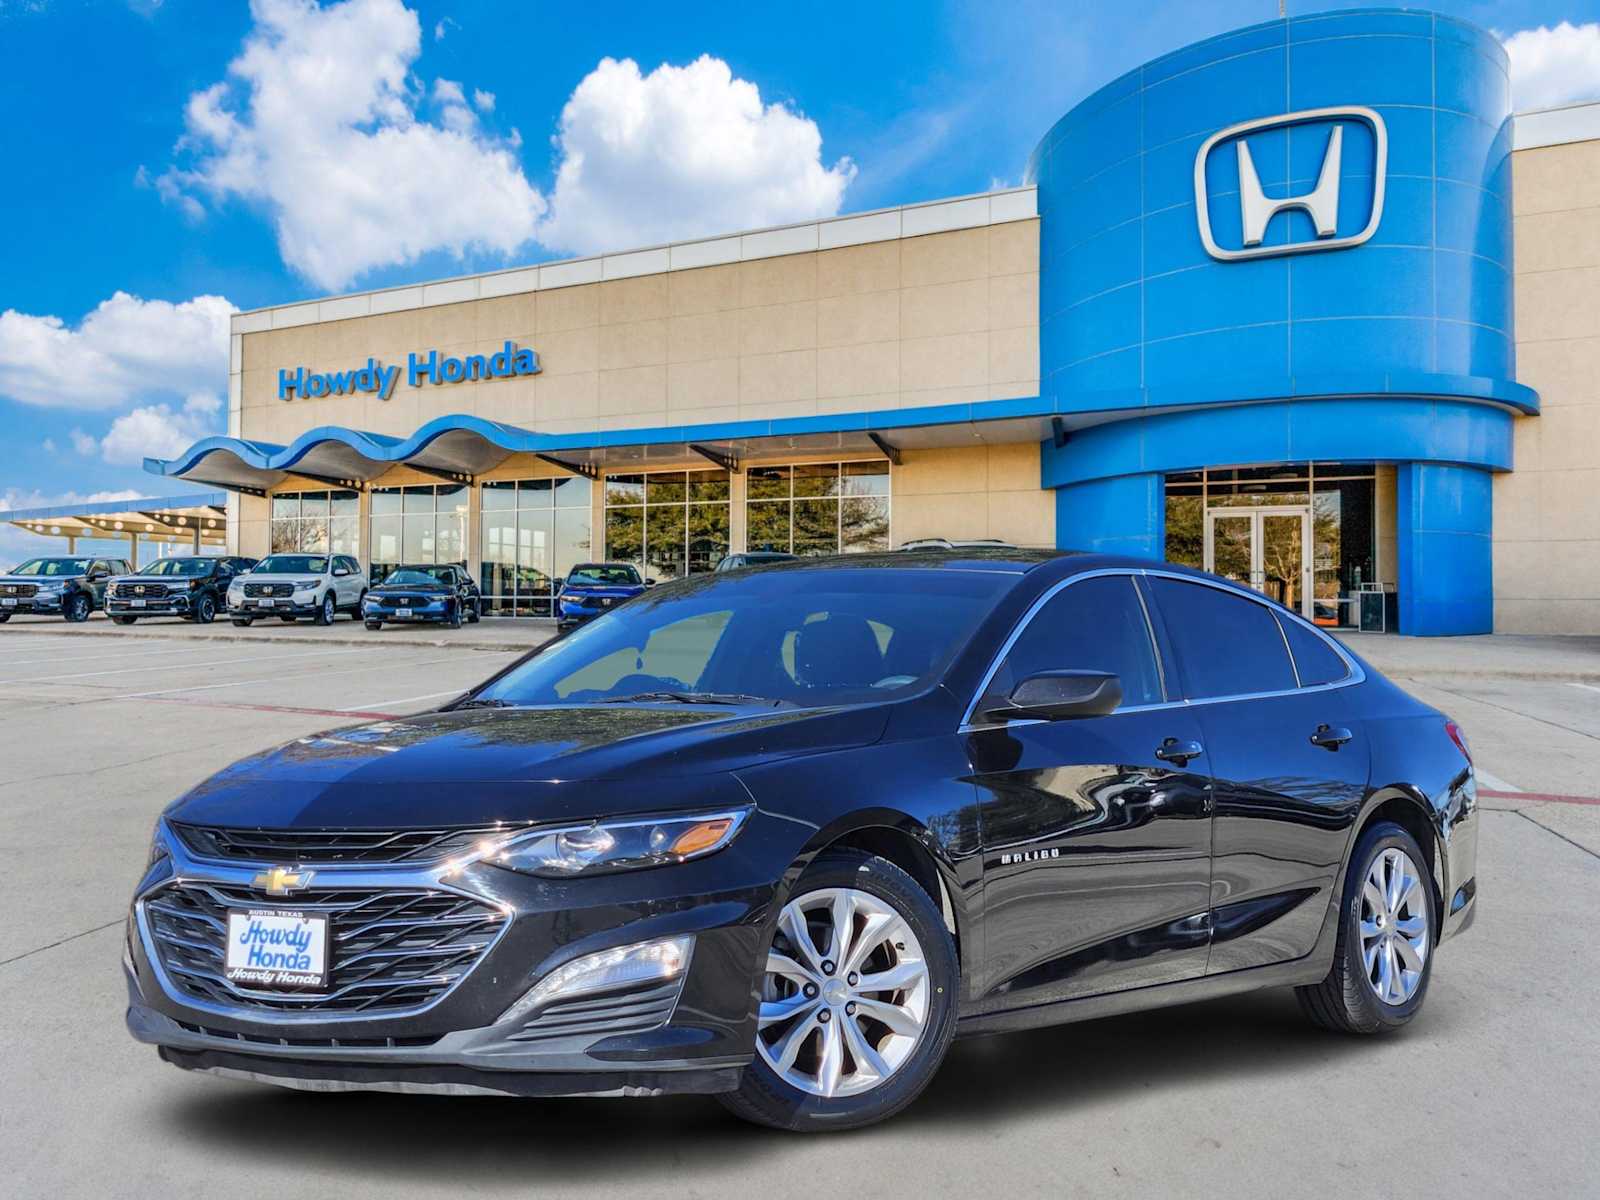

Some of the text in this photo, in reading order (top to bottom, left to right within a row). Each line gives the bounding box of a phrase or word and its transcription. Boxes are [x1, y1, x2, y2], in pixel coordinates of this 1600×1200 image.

[278, 340, 541, 400] Howdy Honda
[1001, 848, 1059, 865] MALIBU
[240, 920, 312, 953] Howdy
[247, 944, 312, 970] Honda
[227, 968, 322, 985] Howdy Honda
